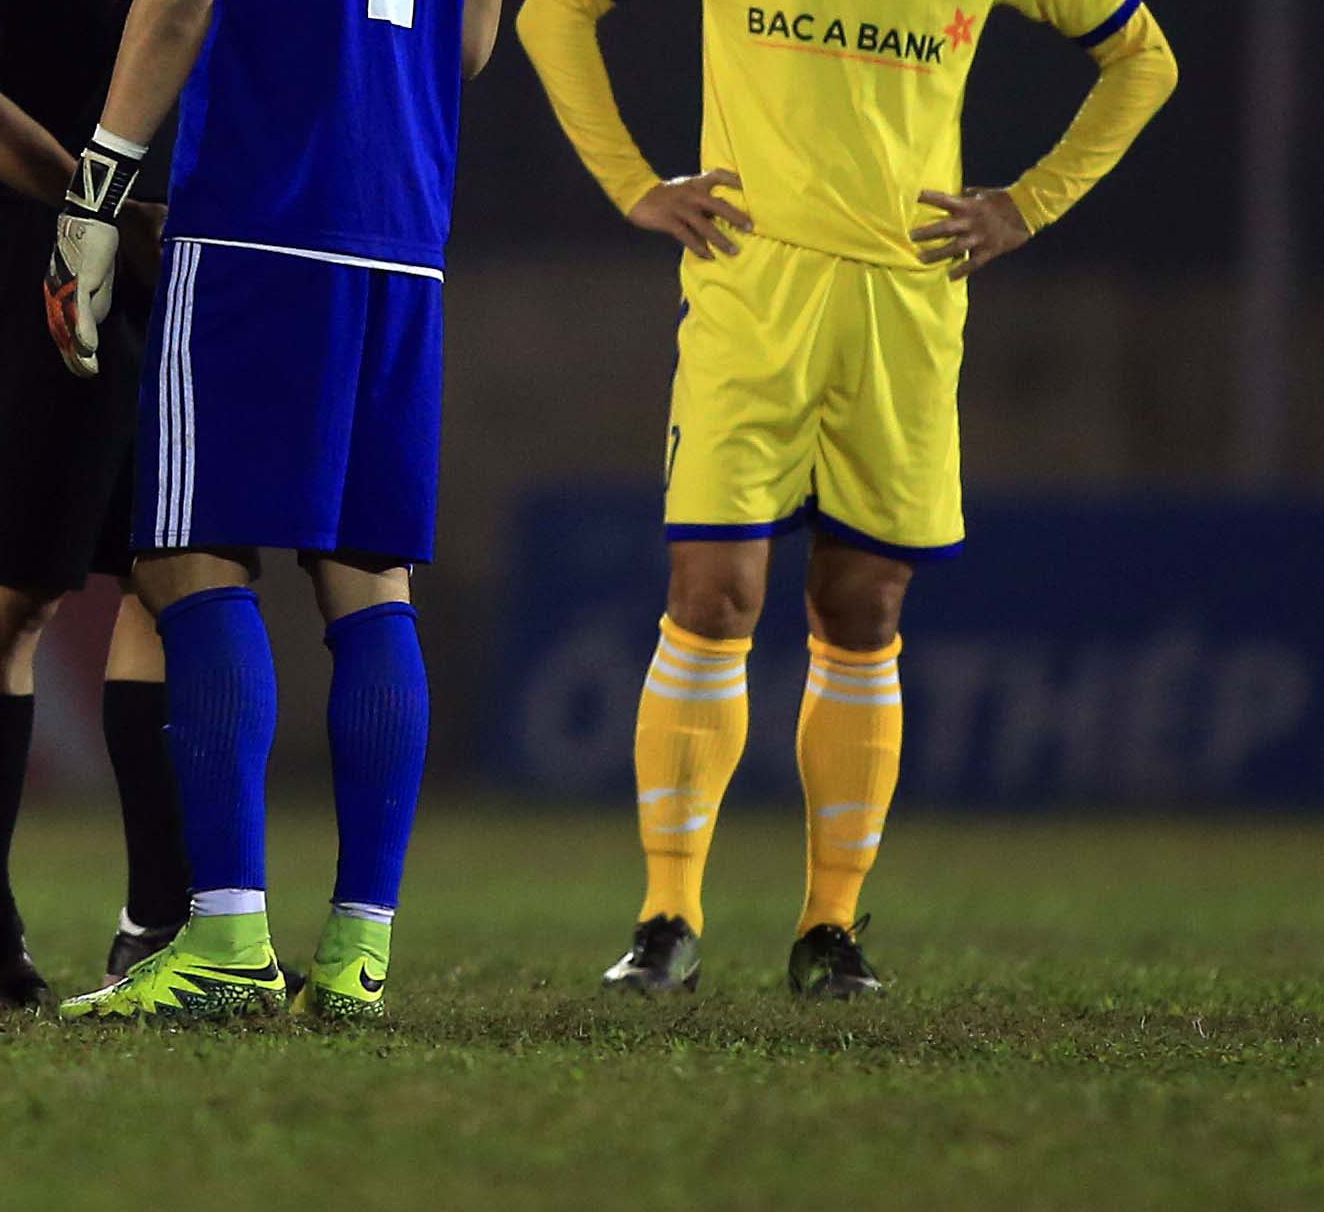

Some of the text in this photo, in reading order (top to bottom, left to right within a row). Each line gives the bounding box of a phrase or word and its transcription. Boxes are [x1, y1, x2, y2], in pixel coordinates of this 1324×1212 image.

[748, 6, 946, 64] BAC A BANK
